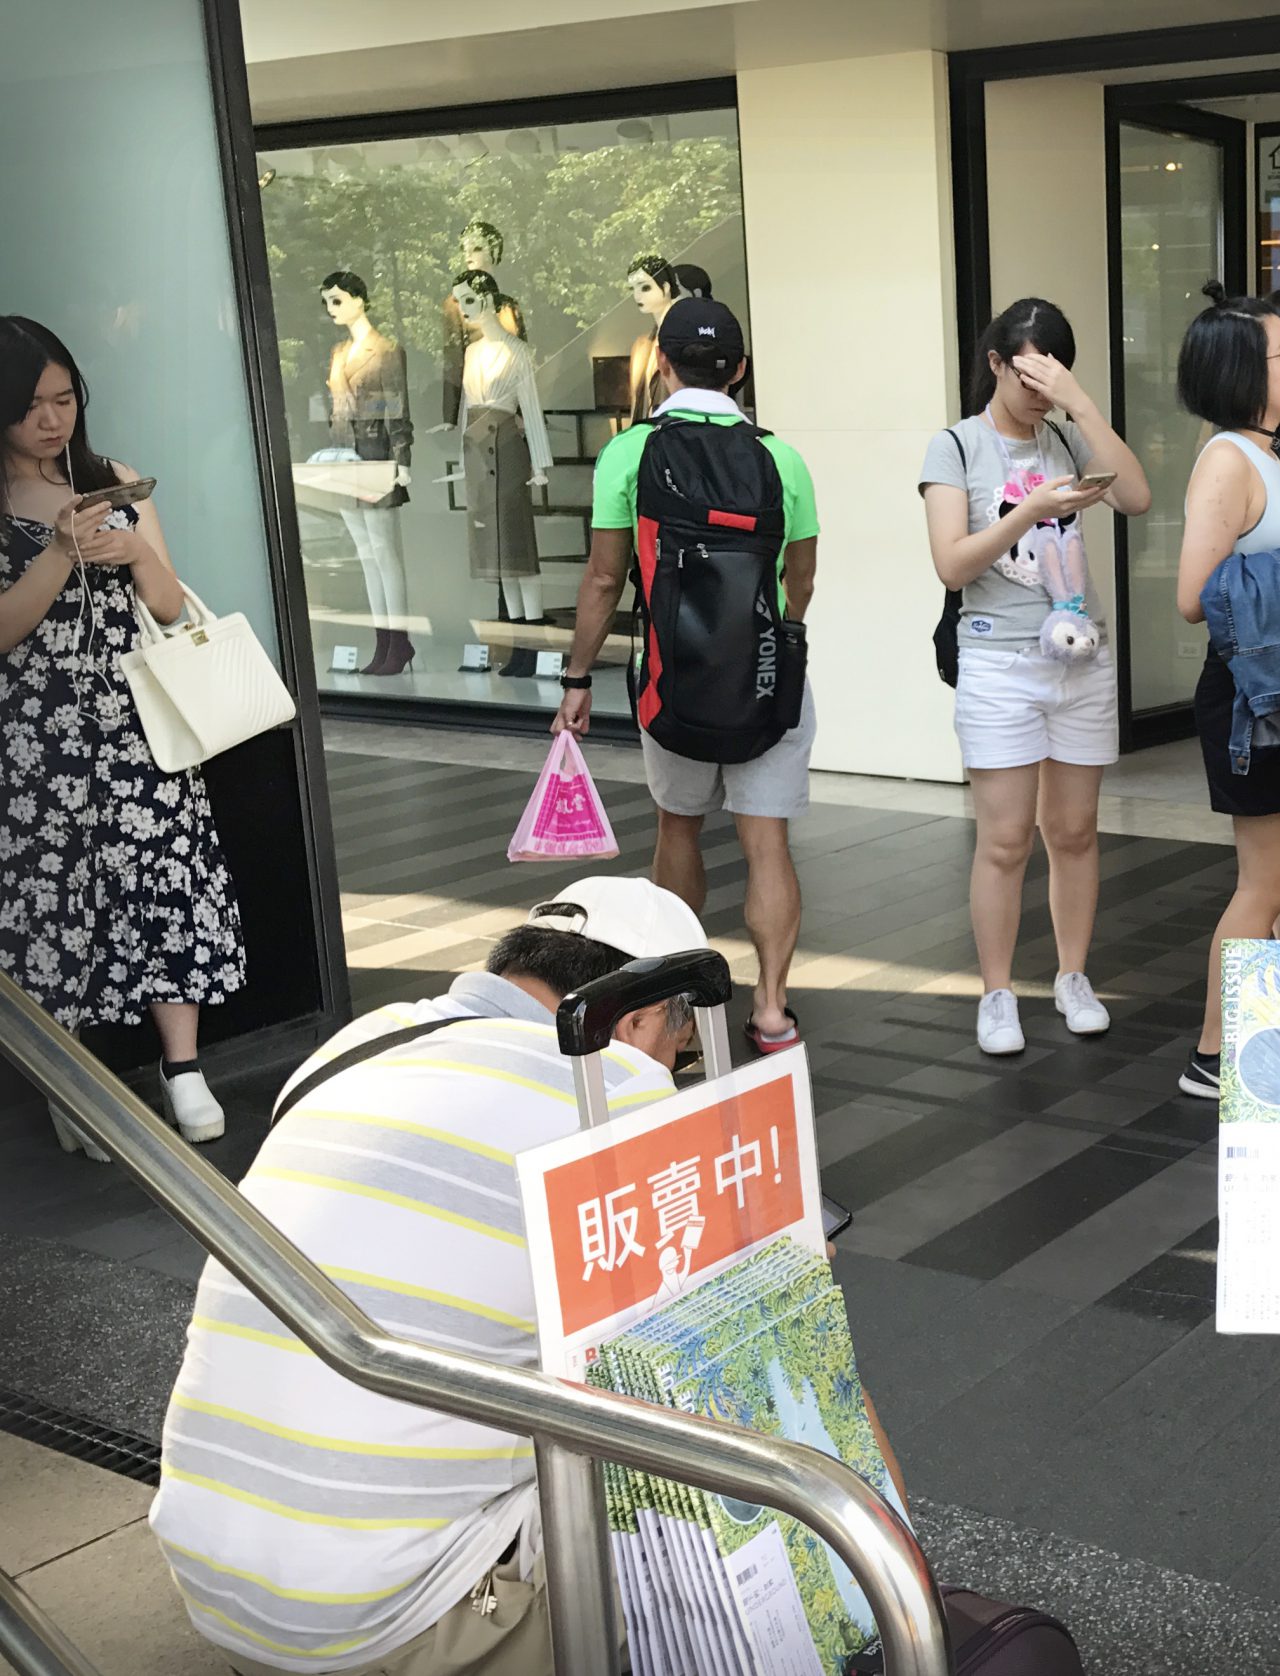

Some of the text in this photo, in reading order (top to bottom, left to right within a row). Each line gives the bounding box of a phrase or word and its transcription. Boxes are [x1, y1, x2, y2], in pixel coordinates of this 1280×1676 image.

[757, 626, 776, 700] YONEX
[1225, 948, 1241, 1043] BIG ISSUE
